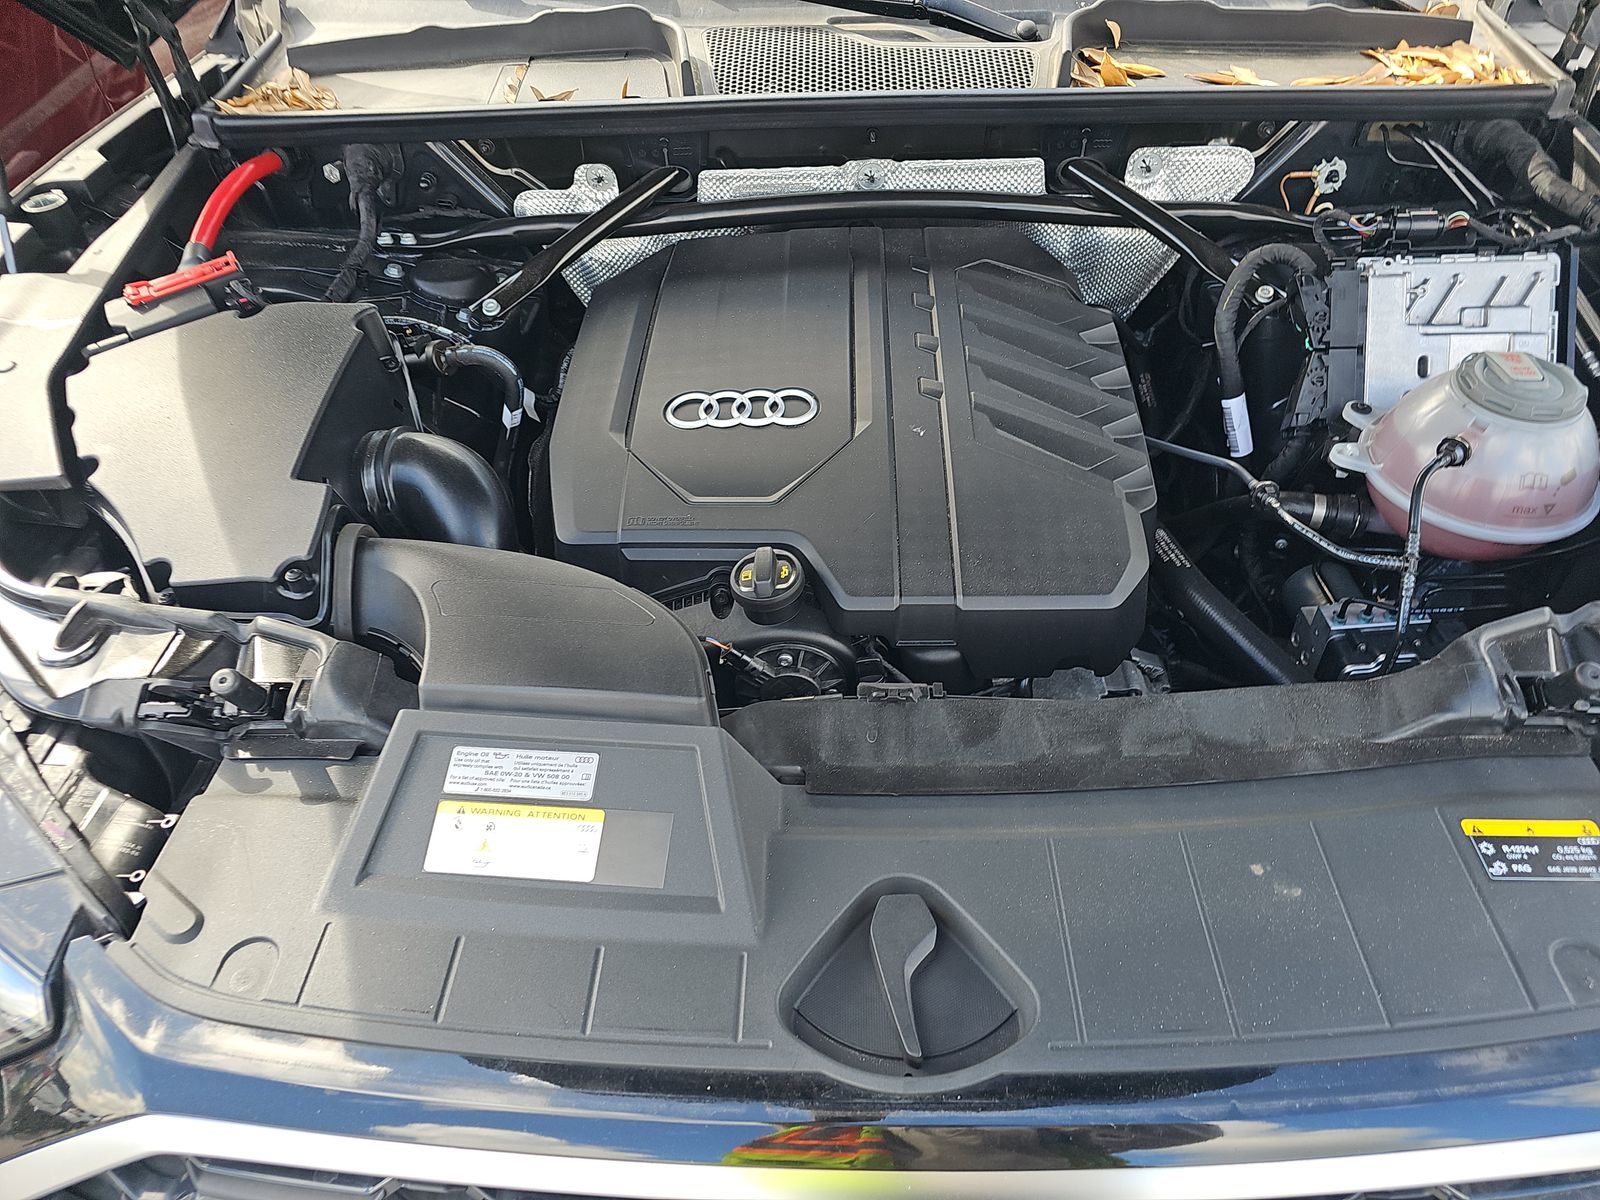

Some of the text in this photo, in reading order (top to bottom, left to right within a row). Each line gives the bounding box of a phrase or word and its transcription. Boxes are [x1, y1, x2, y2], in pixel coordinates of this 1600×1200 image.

[1512, 504, 1538, 515] max
[470, 807, 586, 820] WARNING ATTENTION
